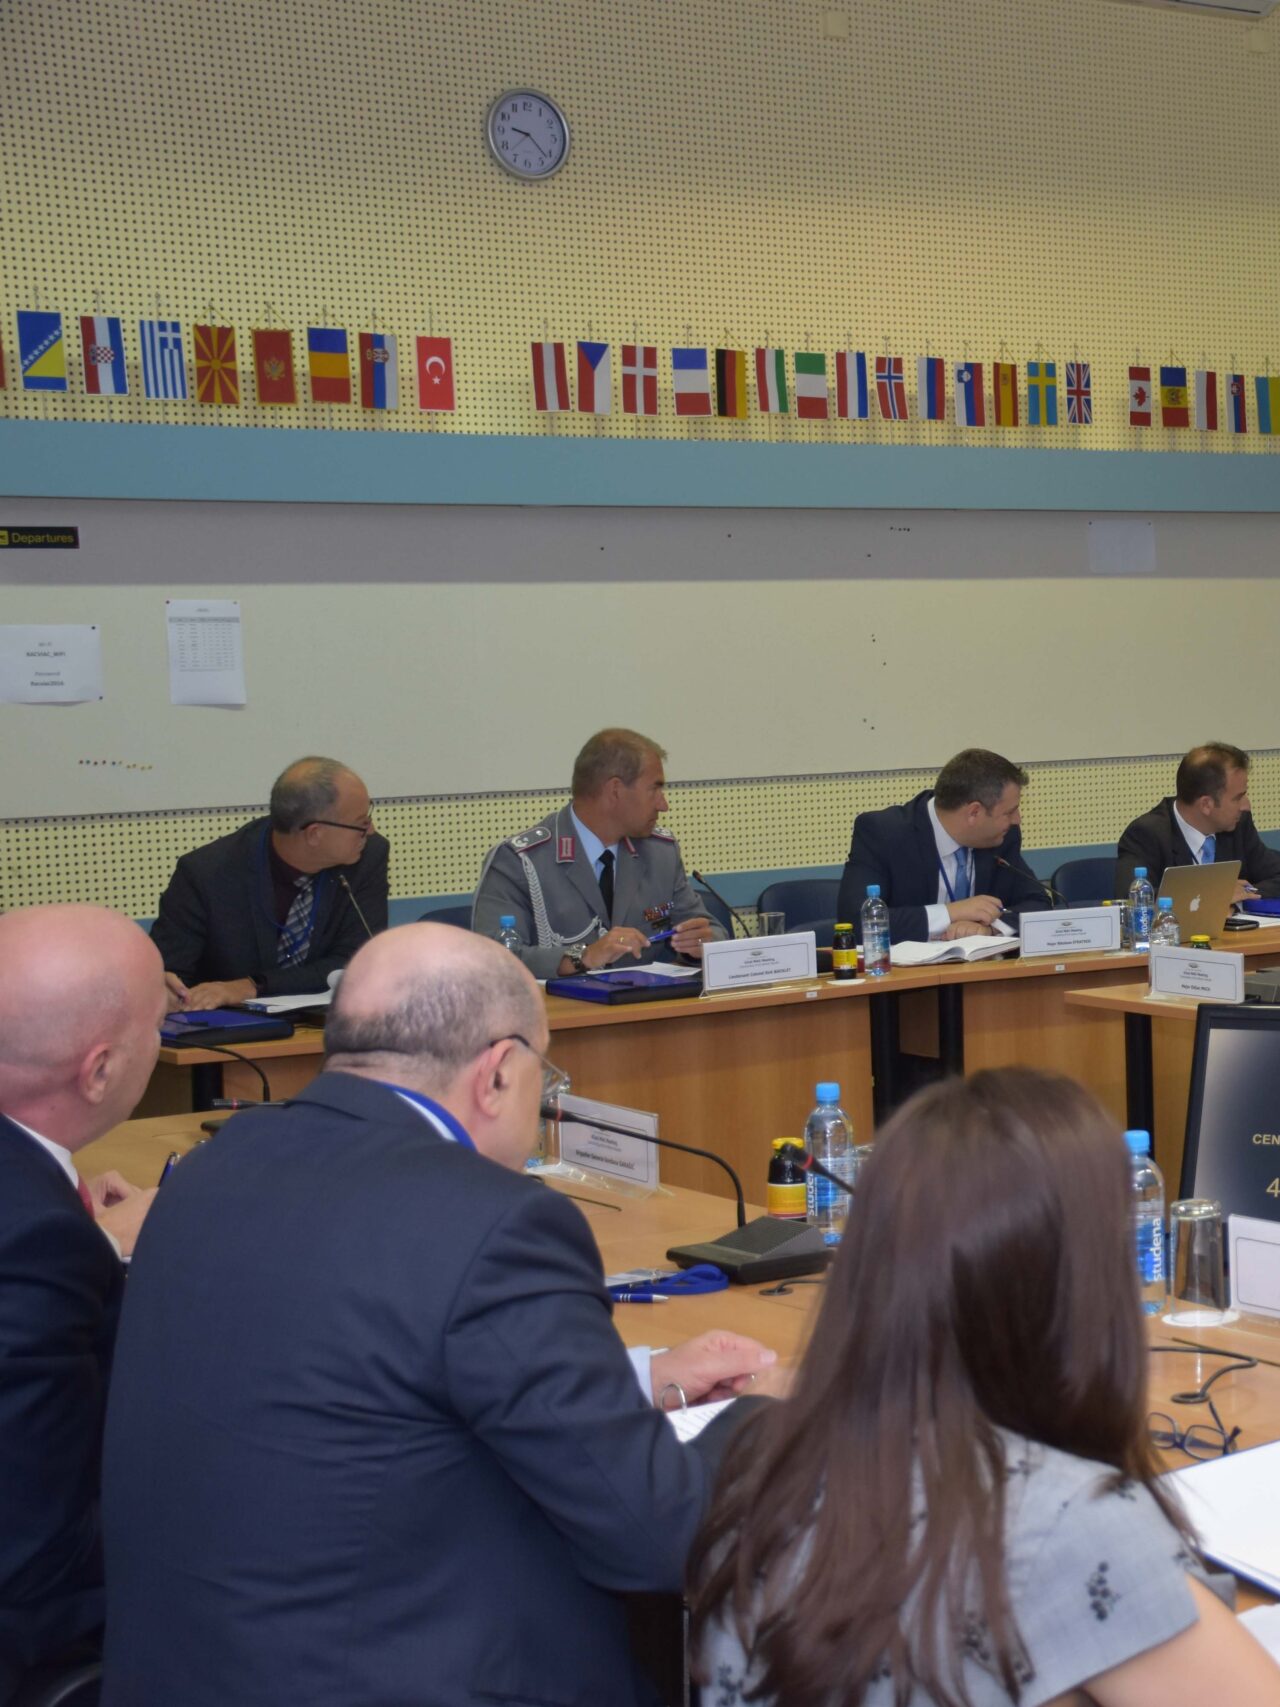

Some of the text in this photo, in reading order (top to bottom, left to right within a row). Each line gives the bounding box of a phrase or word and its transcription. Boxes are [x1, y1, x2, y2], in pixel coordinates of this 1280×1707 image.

[512, 103, 519, 113] 11
[523, 101, 533, 112] 12
[501, 112, 511, 121] 10
[538, 107, 543, 117] 1
[546, 119, 554, 129] 2
[497, 125, 505, 135] 9
[550, 134, 558, 144] 3
[501, 140, 509, 150] 8
[512, 153, 520, 163] 7
[538, 157, 545, 167] 5
[524, 159, 532, 168] 6
[11, 532, 75, 545] Departures
[1150, 1217, 1162, 1282] studena
